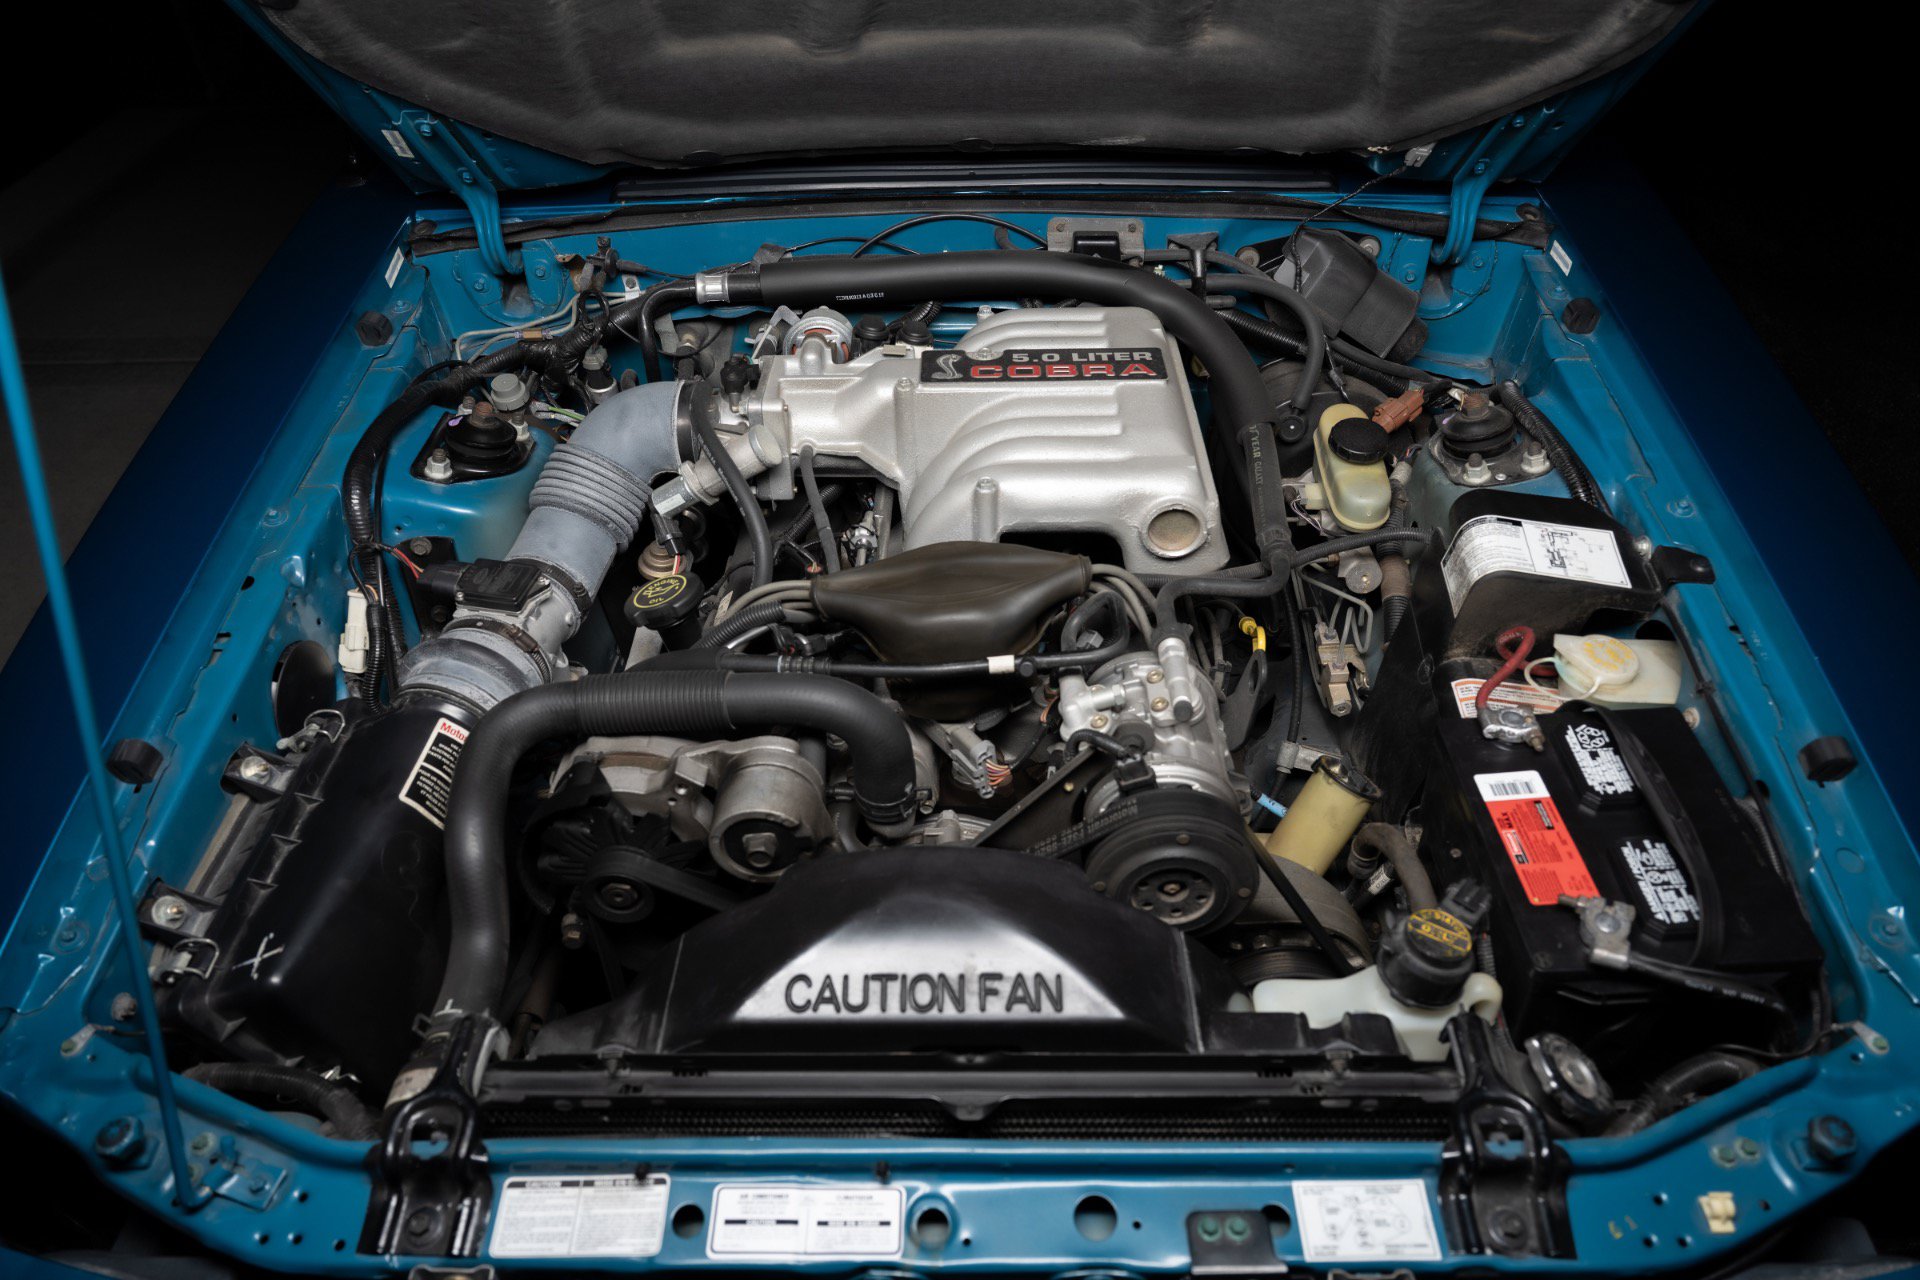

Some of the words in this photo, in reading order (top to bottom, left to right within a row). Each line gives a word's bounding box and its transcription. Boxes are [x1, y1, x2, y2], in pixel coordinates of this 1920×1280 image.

[1011, 352, 1058, 362] 5.0
[1071, 351, 1153, 362] LITER
[970, 363, 1158, 379] COBRA
[648, 578, 680, 590] ENGINE
[648, 597, 665, 605] OIL
[785, 973, 966, 1013] CAUTION
[979, 972, 1064, 1012] FAN
